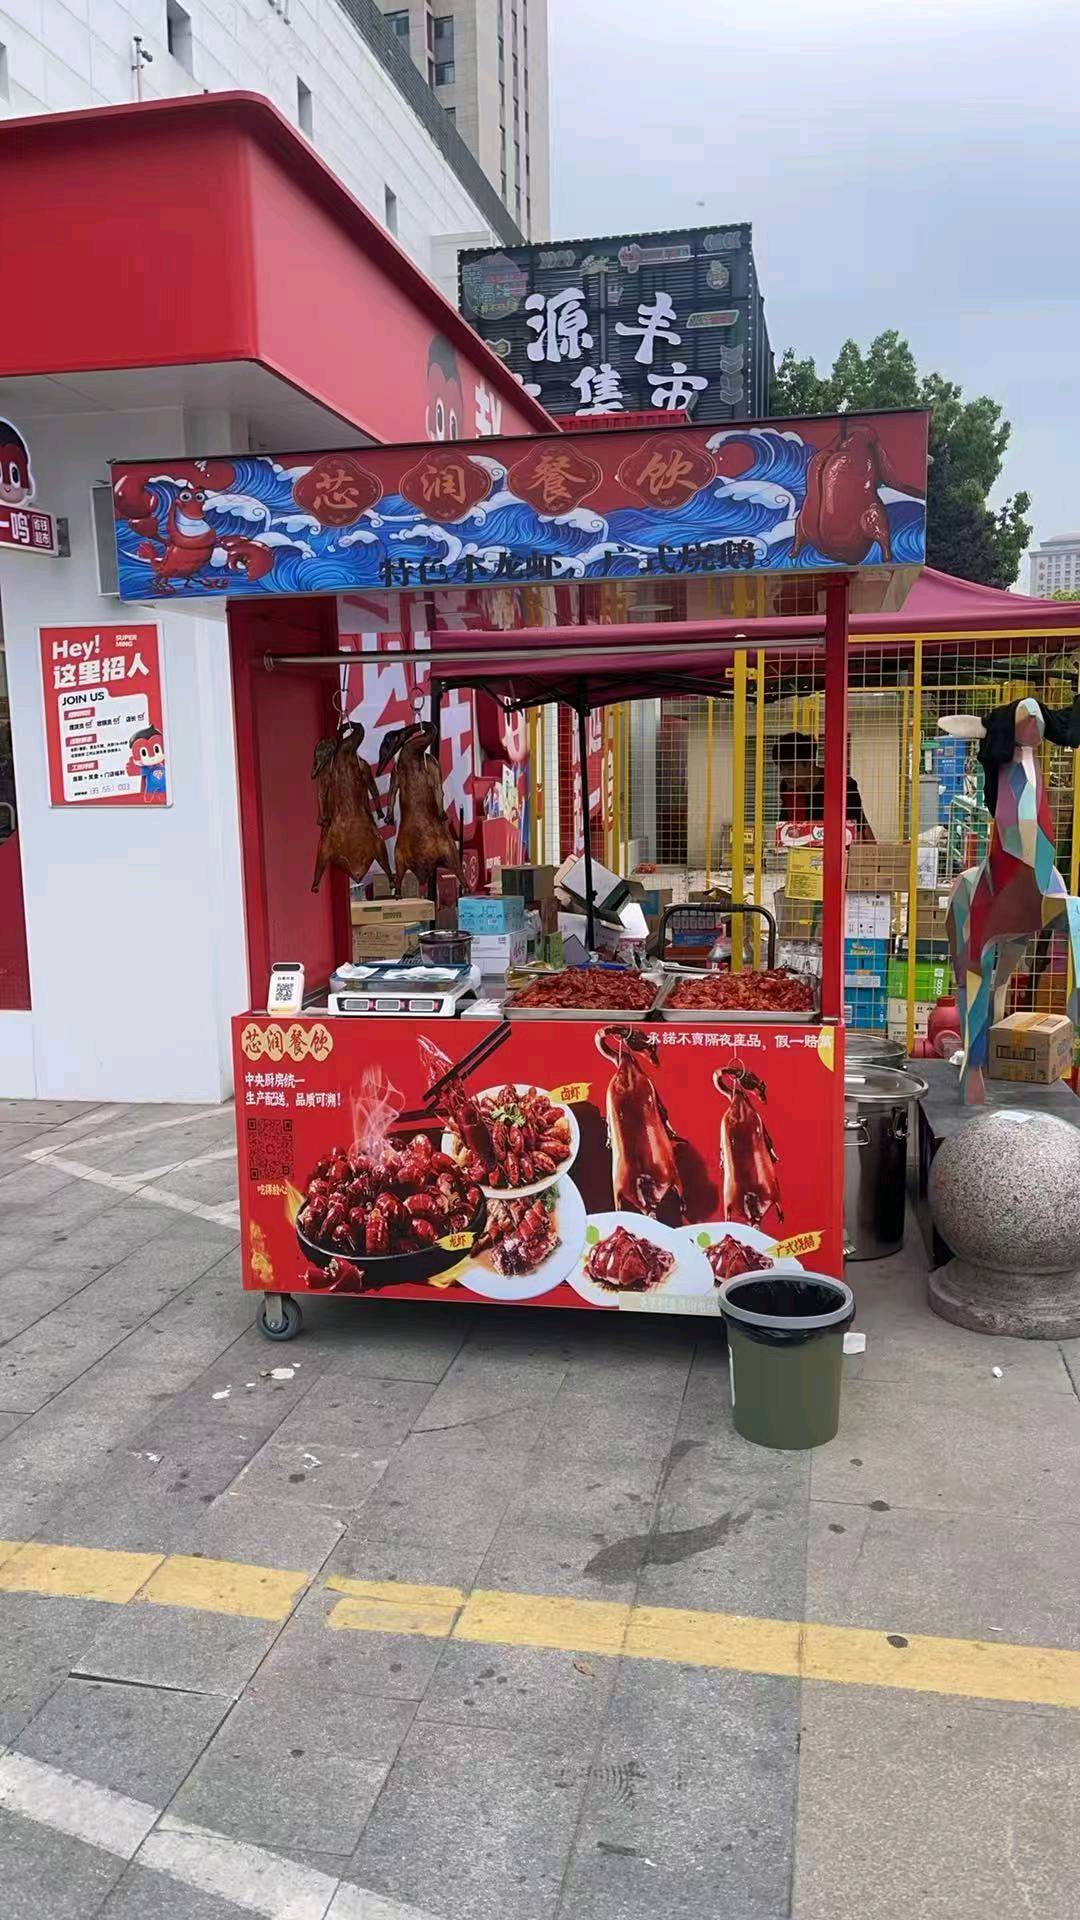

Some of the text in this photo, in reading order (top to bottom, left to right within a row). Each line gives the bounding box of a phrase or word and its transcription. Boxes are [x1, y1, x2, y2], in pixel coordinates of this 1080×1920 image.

[524, 287, 682, 365] 源丰
[313, 449, 698, 510] 芯润餐饮
[52, 634, 100, 661] Hey!
[53, 652, 150, 690] 这里招人
[62, 691, 105, 706] JOIN US
[245, 1029, 330, 1056] 芯润餐饮
[245, 1071, 305, 1089] 中央厨房统一
[560, 1085, 581, 1101] 卤虾
[257, 1184, 288, 1196] 吃得放心
[776, 1234, 815, 1258] 广式烧鹅
